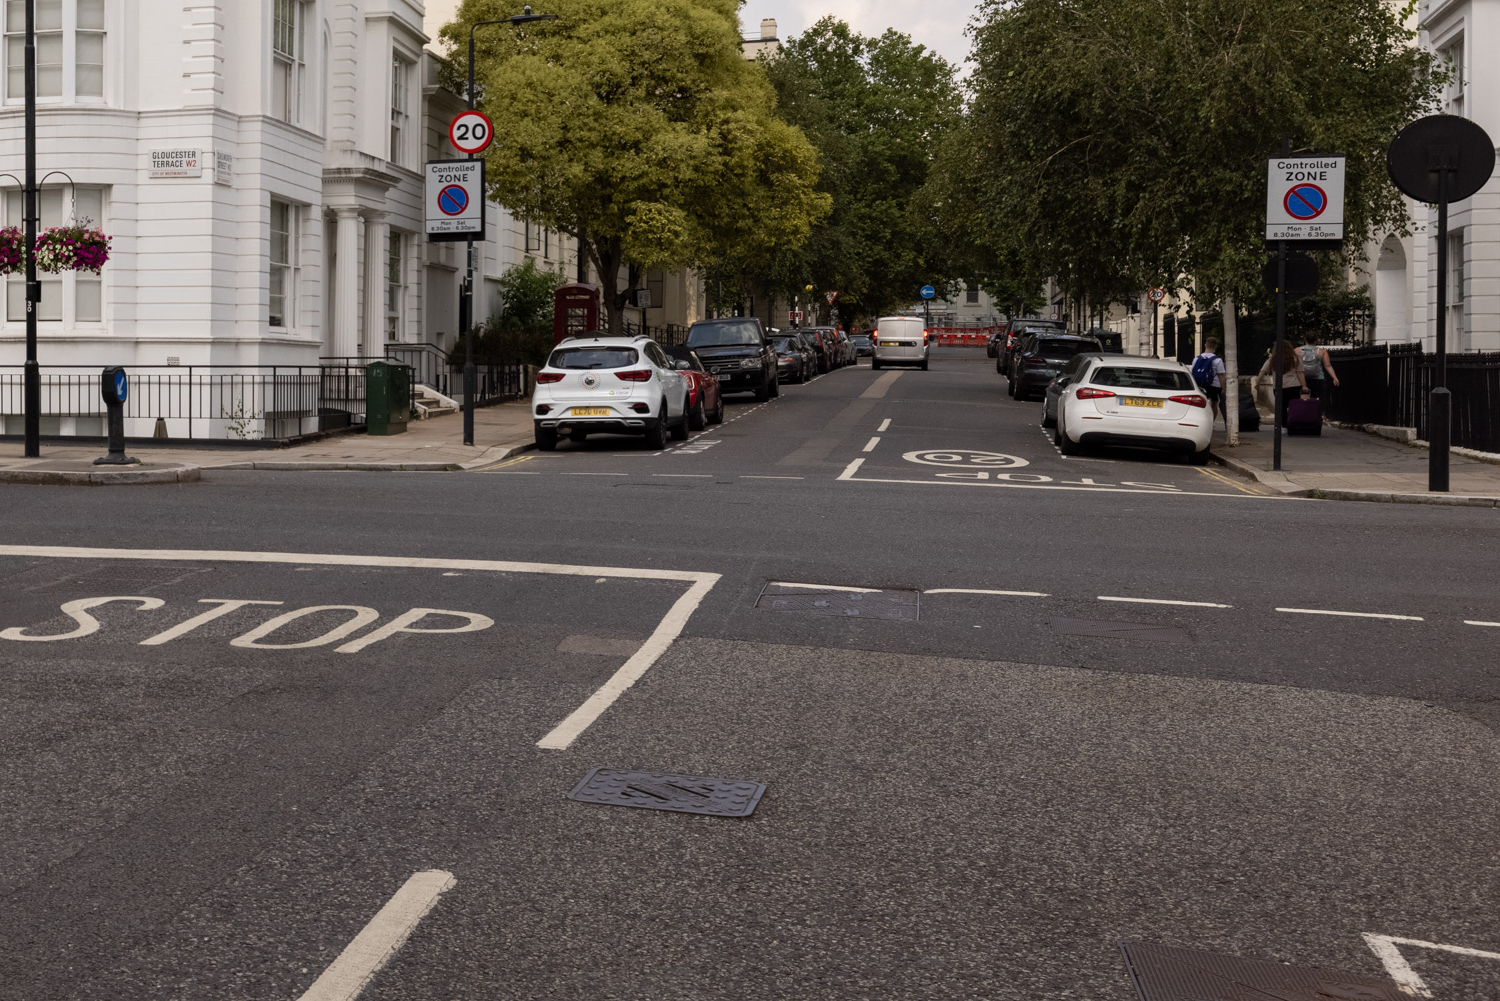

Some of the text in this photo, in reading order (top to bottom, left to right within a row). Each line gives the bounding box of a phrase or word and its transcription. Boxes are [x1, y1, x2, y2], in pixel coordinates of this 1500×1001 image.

[456, 123, 486, 141] 20
[152, 151, 196, 160] GLOUCESTER
[153, 160, 197, 168] TERRACE W2
[431, 164, 475, 174] Controlled
[1277, 161, 1337, 170] Controlled
[438, 174, 468, 183] ZONE
[1285, 171, 1328, 181] ZONE
[27, 300, 32, 313] 30
[935, 471, 1182, 492] STOP
